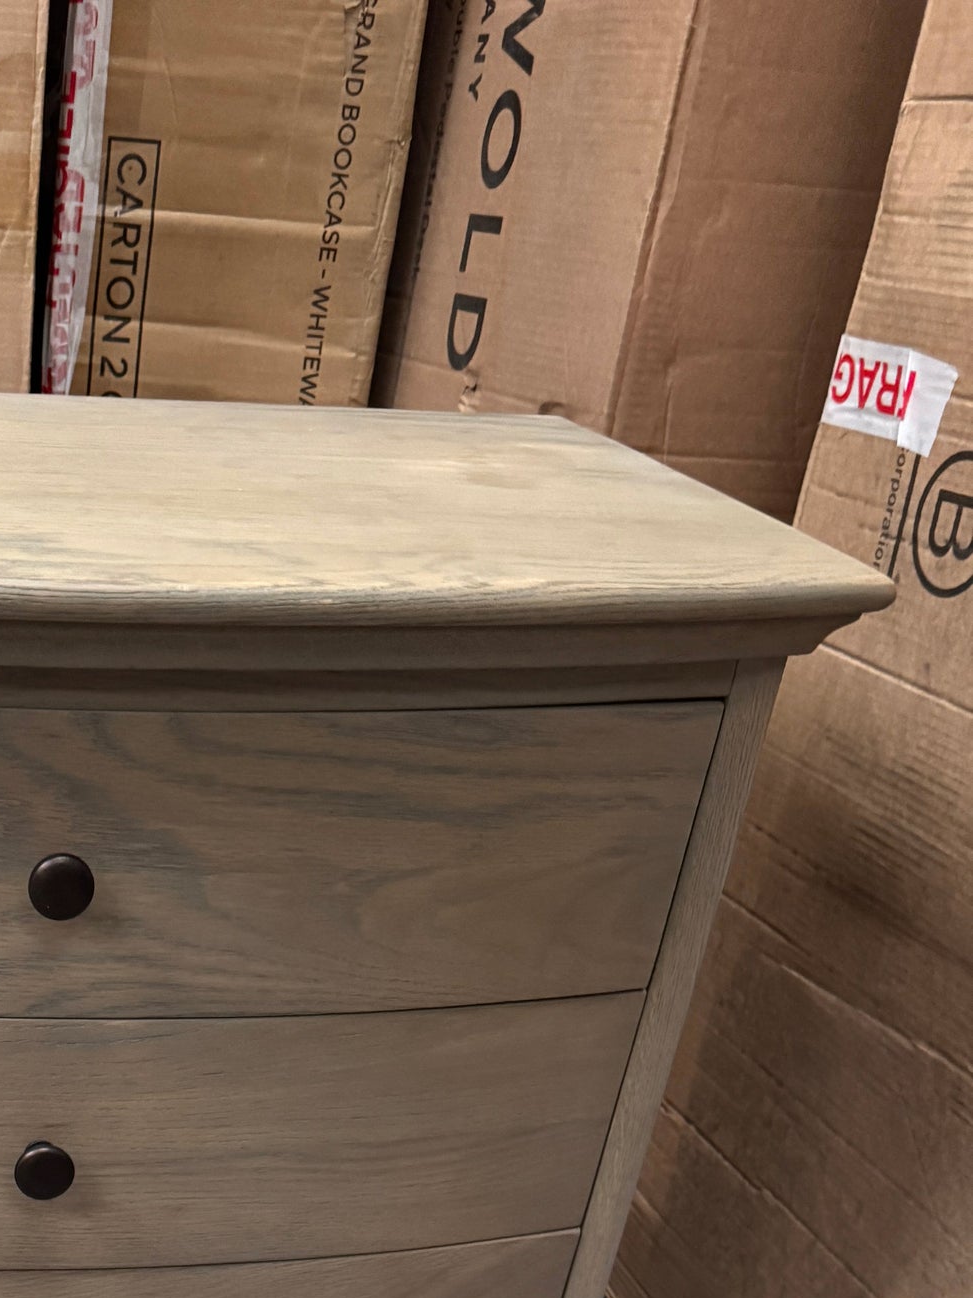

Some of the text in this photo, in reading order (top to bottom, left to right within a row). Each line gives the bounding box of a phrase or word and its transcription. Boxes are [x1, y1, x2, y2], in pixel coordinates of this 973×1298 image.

[102, 153, 147, 343] CARTON
[319, 104, 361, 262] BOOKCASE
[99, 356, 128, 378] 2
